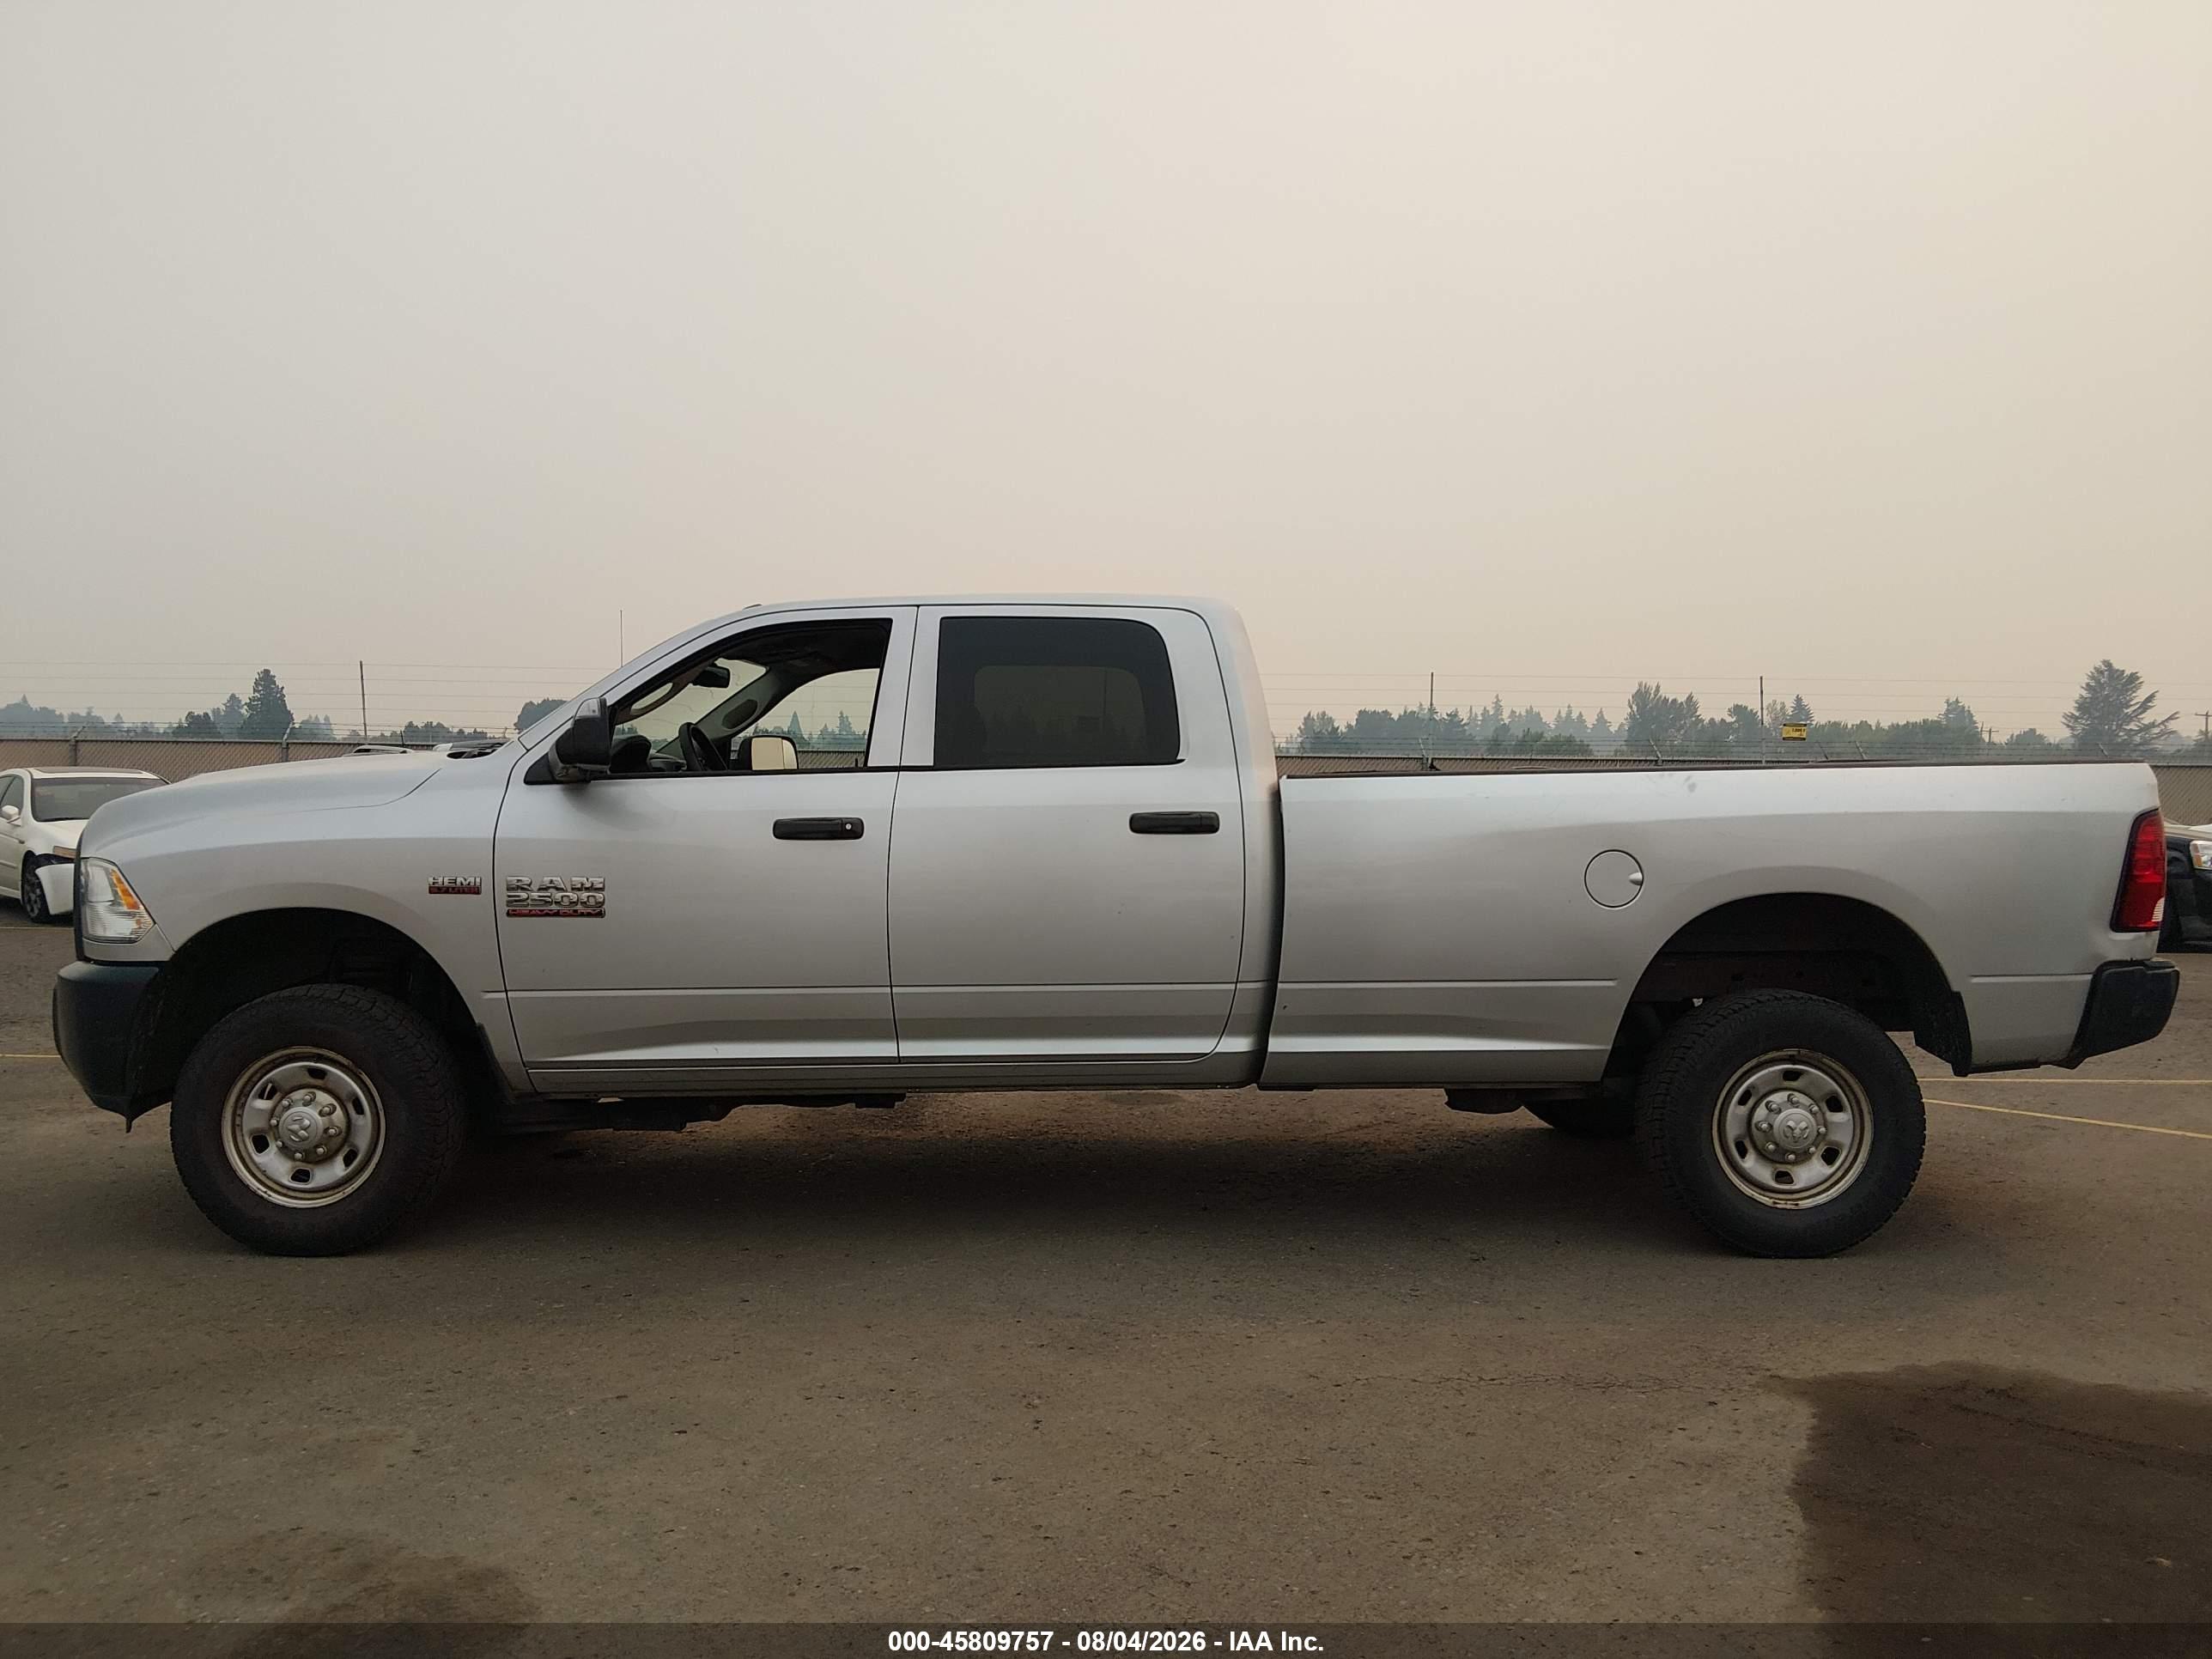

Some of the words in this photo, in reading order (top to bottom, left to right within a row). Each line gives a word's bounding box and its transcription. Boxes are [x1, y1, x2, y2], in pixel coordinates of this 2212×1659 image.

[428, 876, 481, 886] HEMI
[506, 876, 605, 891] RAM
[506, 892, 605, 908] 2500
